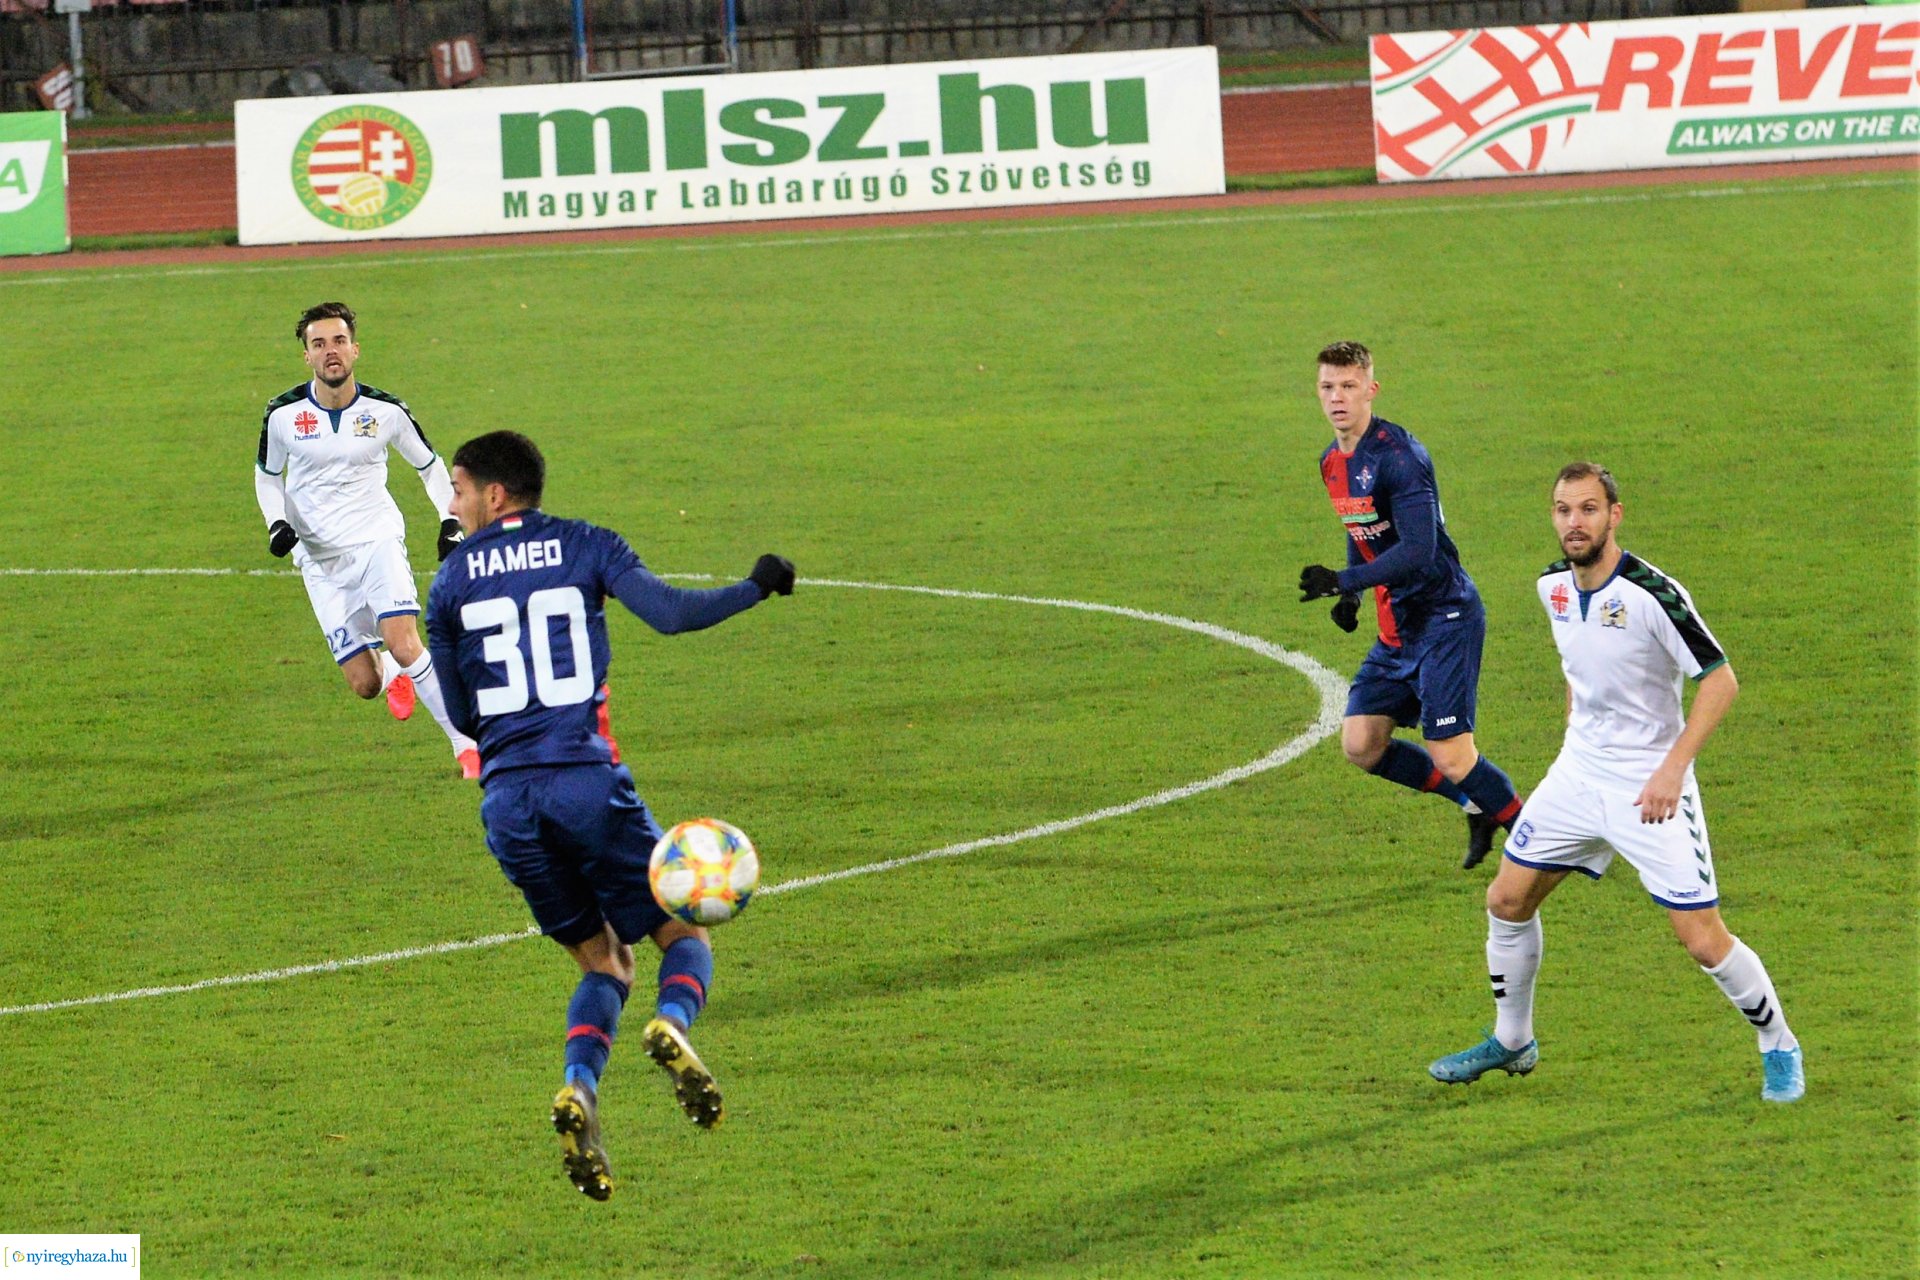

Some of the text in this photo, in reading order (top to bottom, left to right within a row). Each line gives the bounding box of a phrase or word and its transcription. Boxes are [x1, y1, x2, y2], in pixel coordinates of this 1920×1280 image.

[1596, 22, 1920, 112] REVE
[500, 73, 1148, 180] mlsz.hu
[1676, 122, 1789, 148] ALWAYS
[1795, 118, 1835, 142] ON
[1842, 115, 1894, 138] THE
[502, 156, 1151, 219] Magyar Labdarúgó Szövetség
[295, 432, 321, 441] hummel
[467, 539, 563, 580] HAMED
[461, 586, 595, 716] 30
[1436, 716, 1457, 727] JAKO
[1514, 819, 1534, 849] 6
[1667, 888, 1701, 898] hummel
